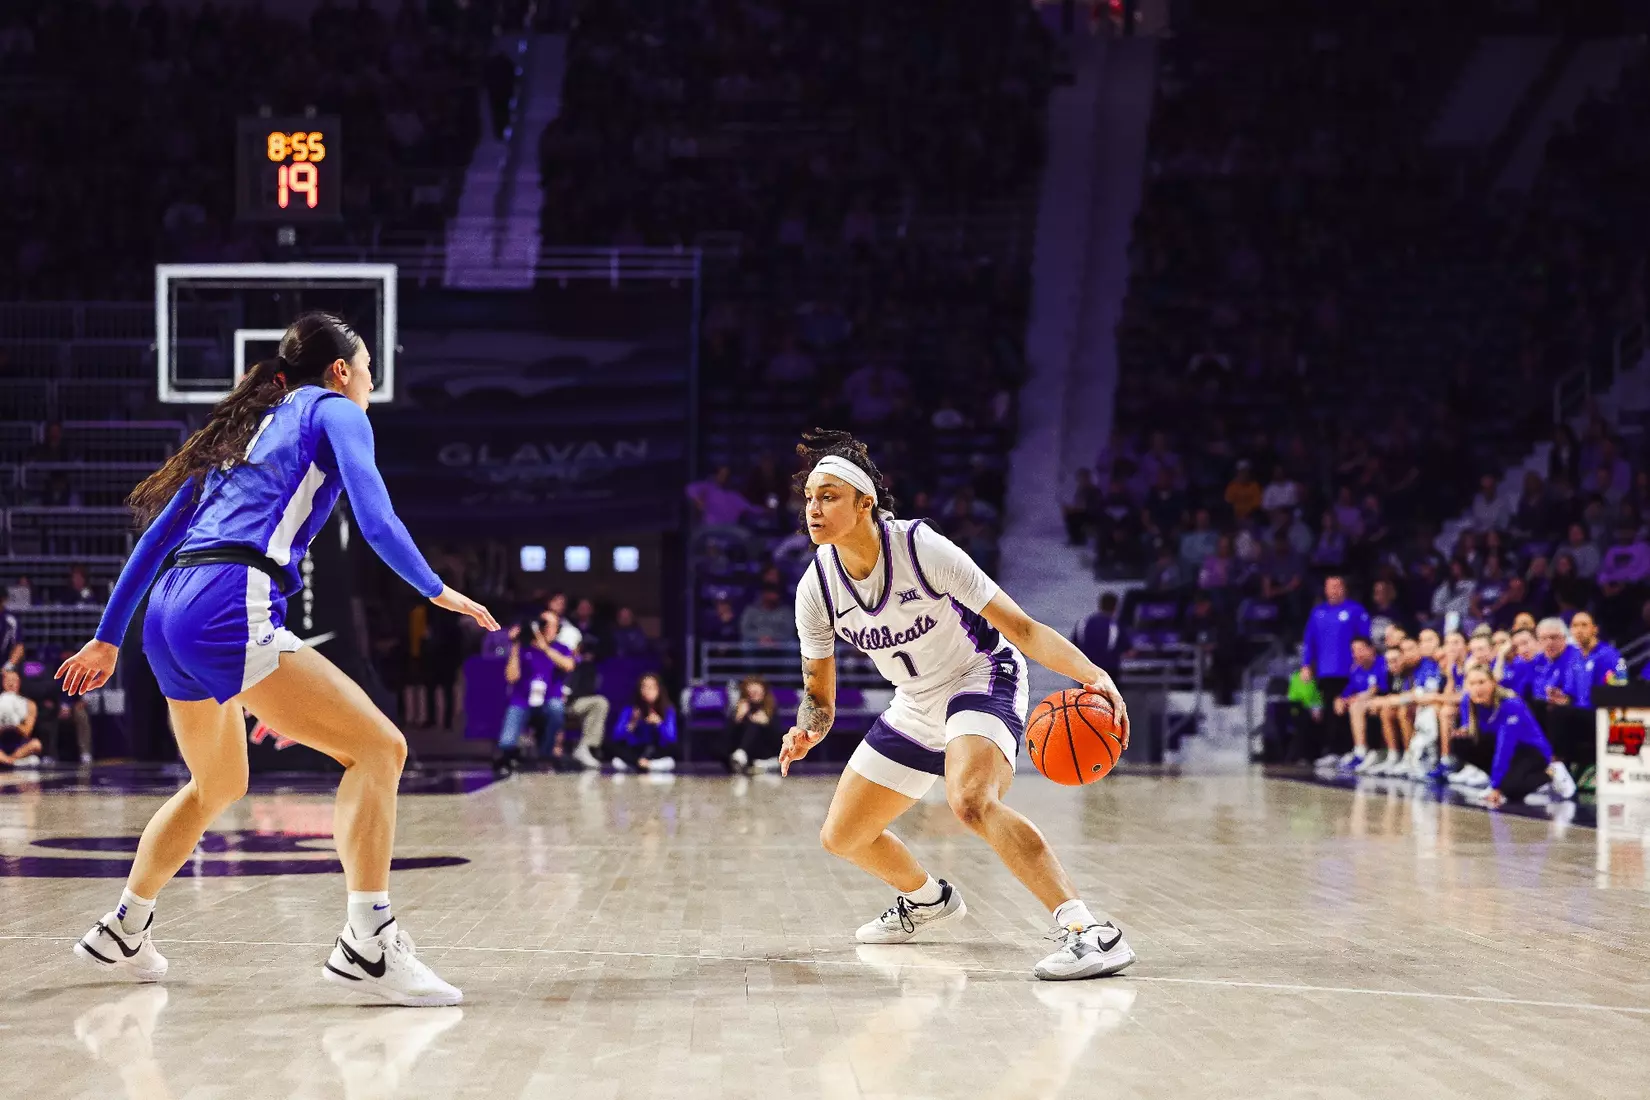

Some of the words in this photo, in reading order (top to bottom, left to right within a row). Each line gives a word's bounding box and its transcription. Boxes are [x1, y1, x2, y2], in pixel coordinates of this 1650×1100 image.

[267, 131, 326, 162] 8:55
[278, 162, 318, 208] 19
[841, 614, 938, 651] Wildcats
[891, 650, 919, 678] 1
